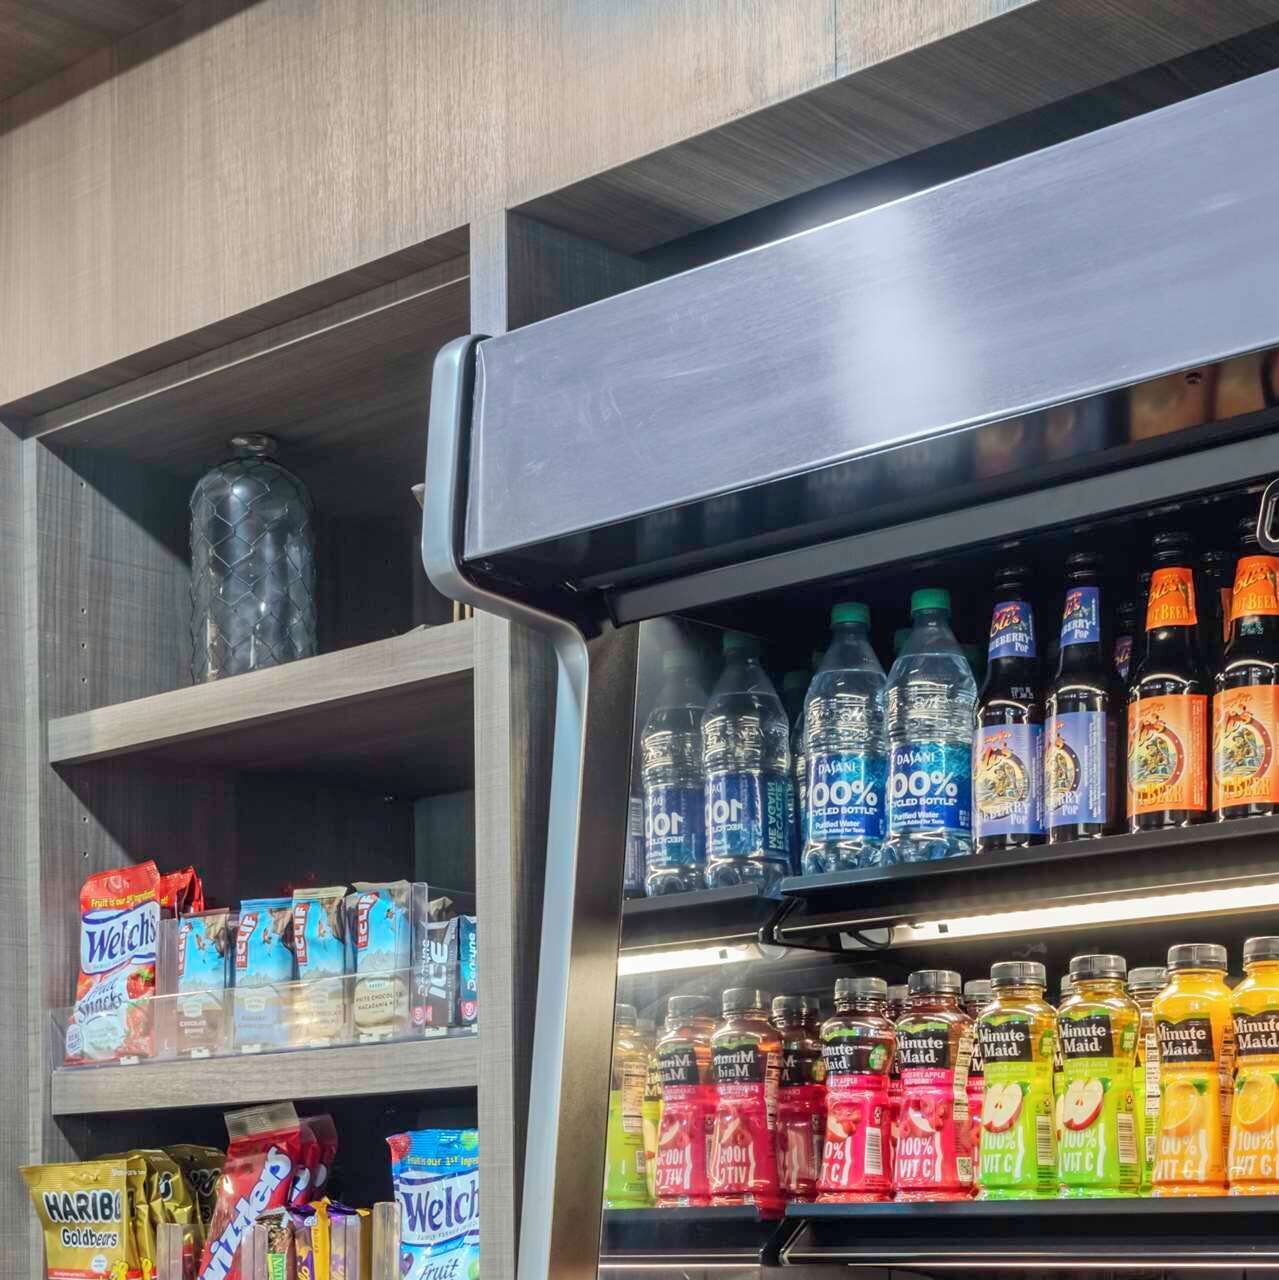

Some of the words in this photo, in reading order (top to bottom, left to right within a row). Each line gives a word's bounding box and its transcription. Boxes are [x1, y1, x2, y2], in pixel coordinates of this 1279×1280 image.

[818, 758, 858, 776] DASANI
[896, 751, 936, 766] DASANI
[810, 780, 878, 807] 00%
[892, 772, 958, 799] 00%
[85, 908, 157, 964] Welch's
[429, 939, 448, 999] ICE
[77, 991, 123, 1025] Snacks
[980, 1028, 1026, 1043] Minute
[1060, 1023, 1107, 1039] Minute
[983, 1043, 1020, 1058] Maid
[1064, 1038, 1101, 1053] Maid
[1162, 1042, 1198, 1057] Maid
[1238, 1033, 1278, 1050] Maid
[901, 1050, 937, 1064] Maid
[901, 1136, 934, 1157] 100%
[984, 1133, 1016, 1151] 100%
[1064, 1131, 1097, 1149] 100%
[1237, 1130, 1274, 1151] 100%
[900, 1159, 920, 1180] VIT
[922, 1157, 932, 1178] C
[984, 1154, 1001, 1173] VIT
[1064, 1152, 1082, 1172] VIT
[402, 1179, 480, 1234] Welch
[62, 1228, 119, 1247] Goldbears
